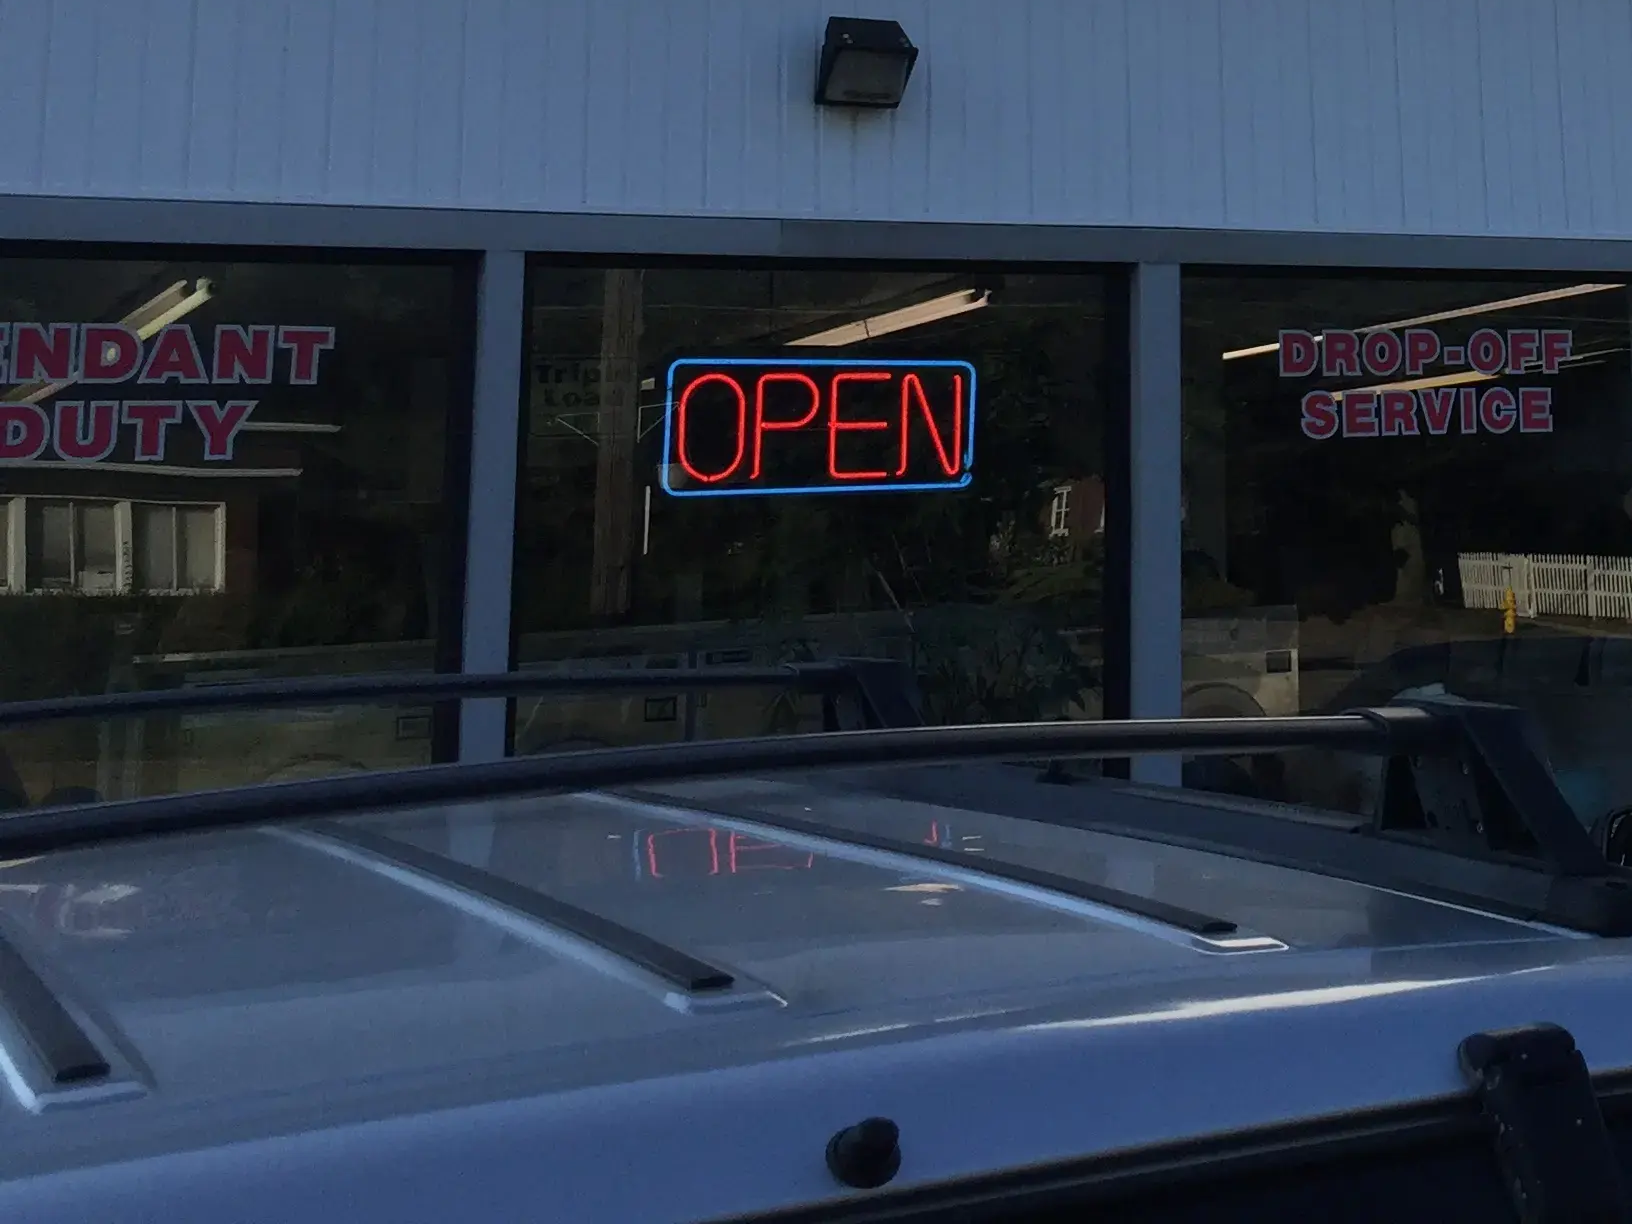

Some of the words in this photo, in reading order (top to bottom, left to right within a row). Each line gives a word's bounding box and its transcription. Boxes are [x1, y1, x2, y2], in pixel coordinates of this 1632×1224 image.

[0, 322, 335, 385] NDANT
[1278, 328, 1573, 377] DROP-OFF
[0, 400, 259, 463] DUTY
[677, 373, 963, 482] OPEN
[1300, 386, 1553, 440] SERVICE
